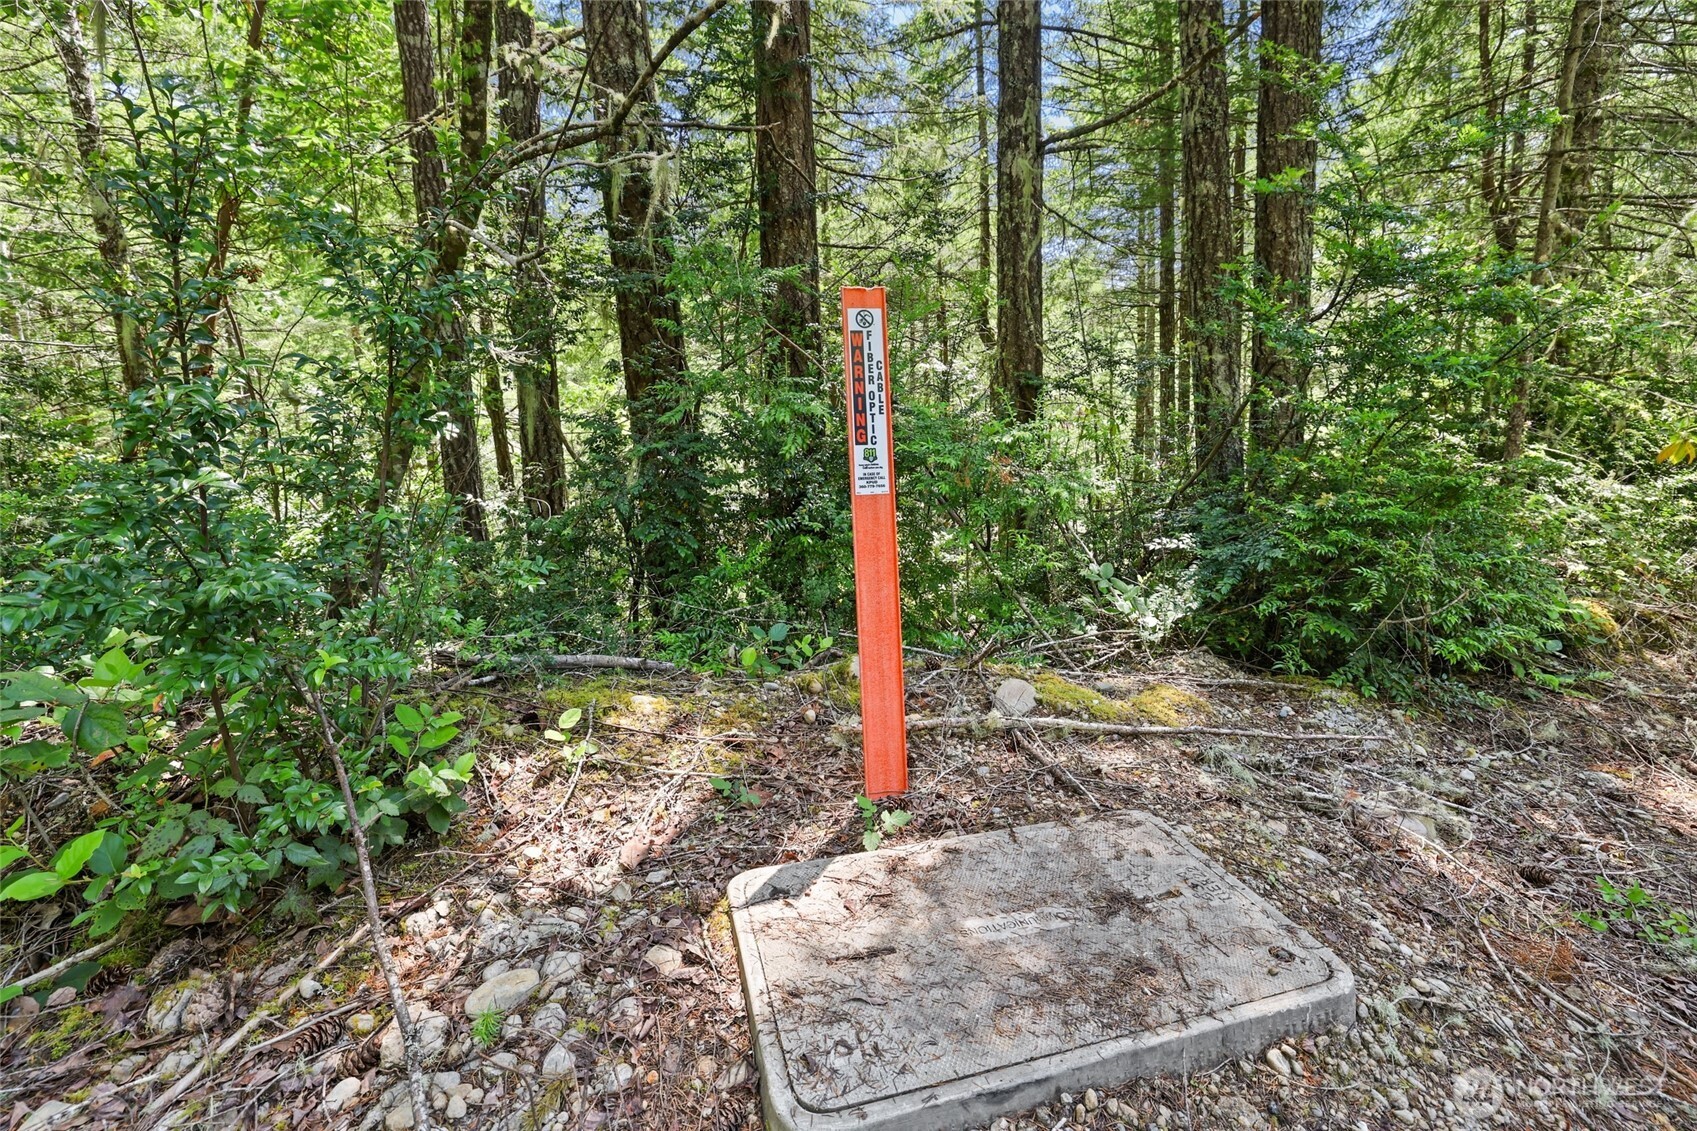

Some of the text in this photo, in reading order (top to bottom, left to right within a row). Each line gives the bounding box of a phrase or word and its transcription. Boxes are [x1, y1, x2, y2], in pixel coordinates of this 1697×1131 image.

[851, 332, 866, 443] WARNING
[866, 330, 877, 445] FIBER OPTIC
[876, 360, 885, 415] CABLE
[864, 448, 876, 458] 811
